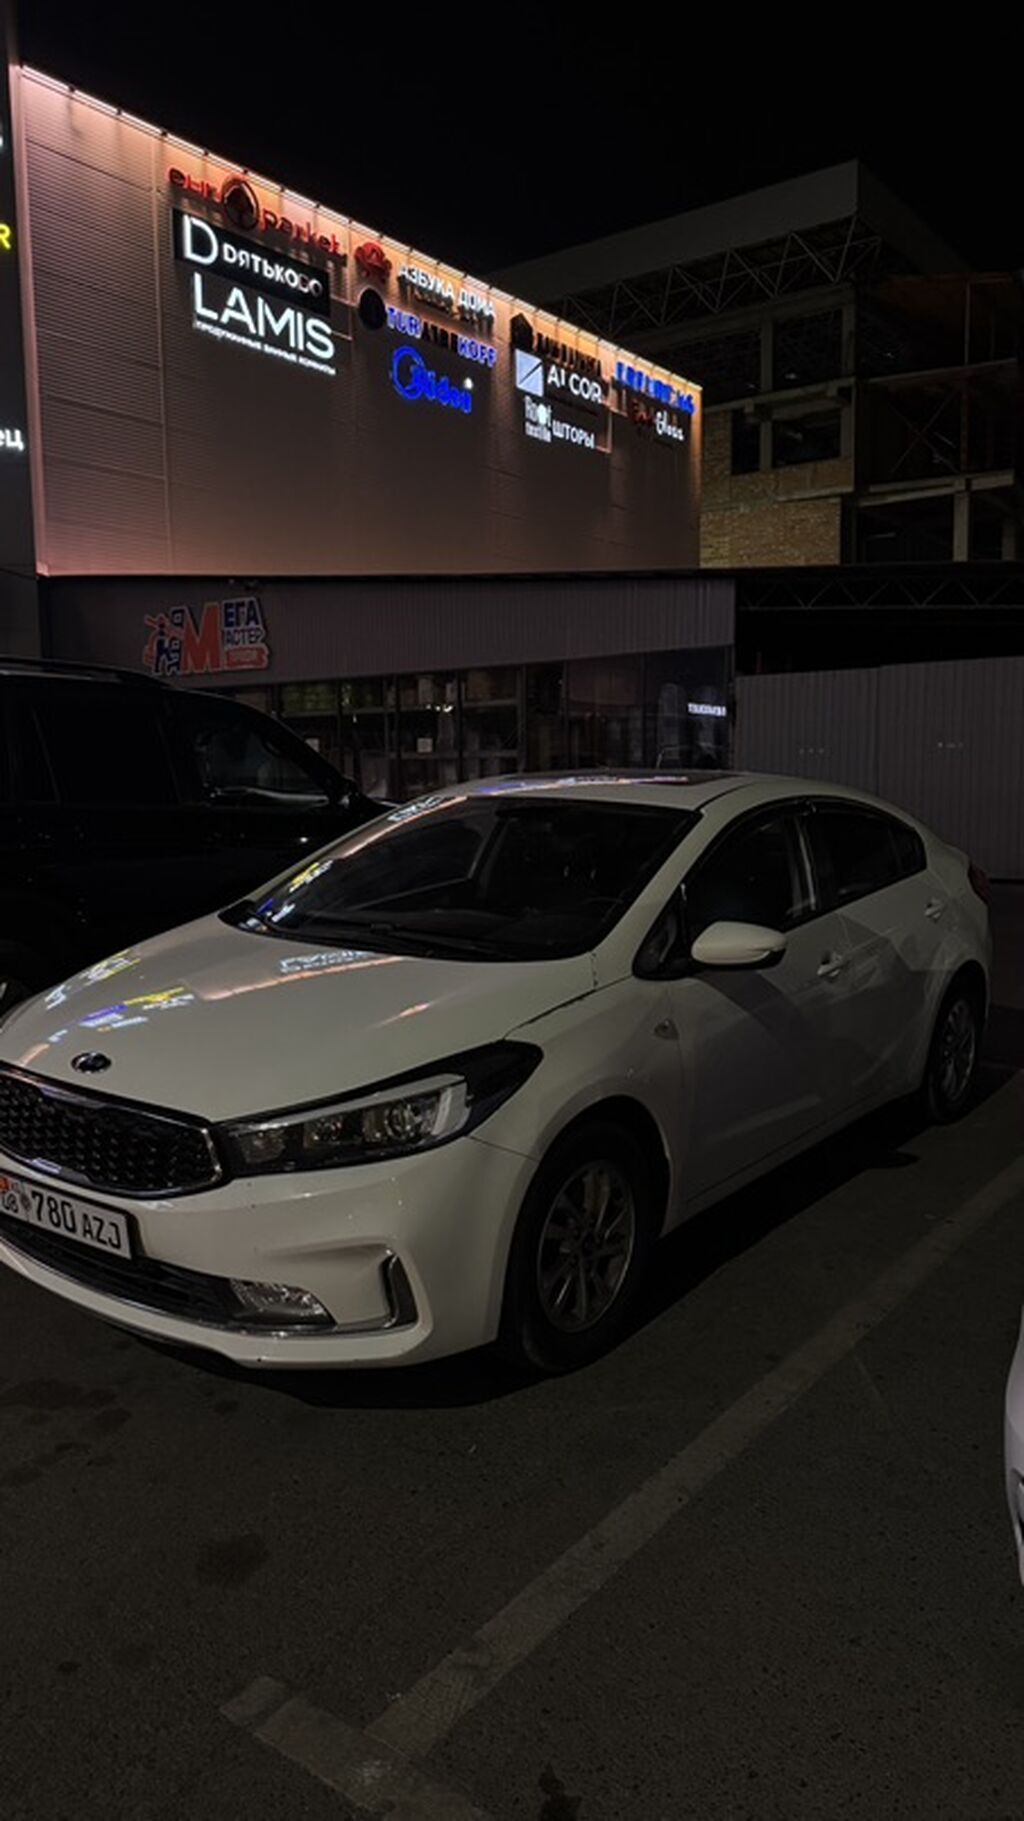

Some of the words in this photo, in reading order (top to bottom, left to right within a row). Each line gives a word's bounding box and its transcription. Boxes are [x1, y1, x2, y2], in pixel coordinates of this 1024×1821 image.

[193, 271, 336, 360] LAMIS
[552, 420, 595, 449] ШТОРЫ
[31, 1190, 77, 1234] 780
[82, 1212, 121, 1249] AZJ
